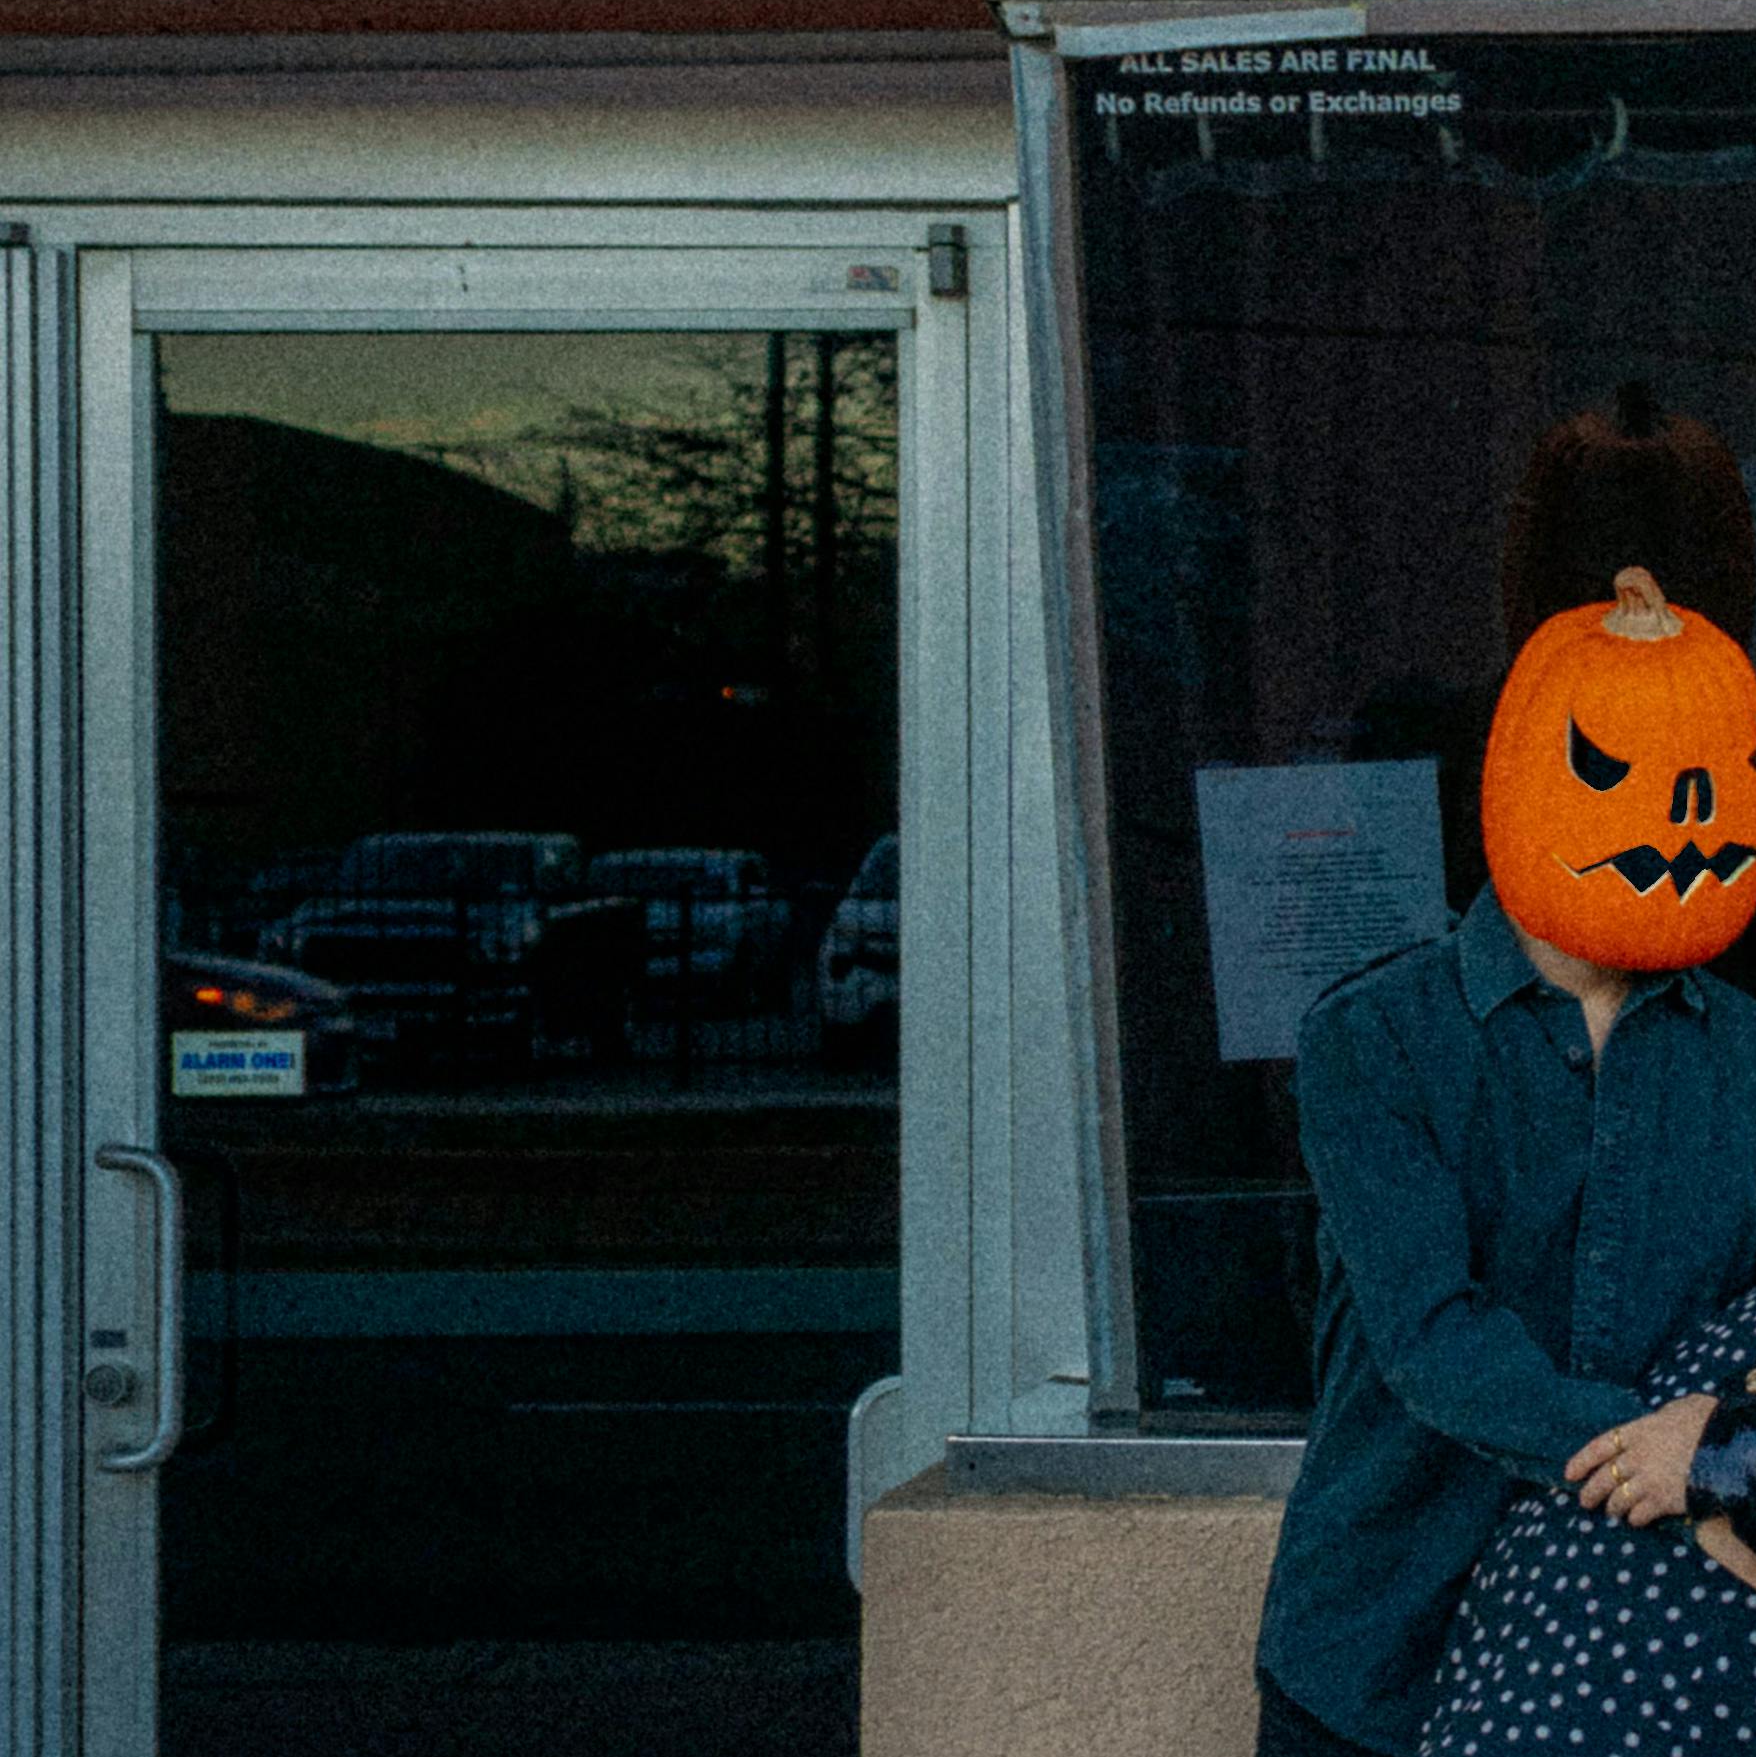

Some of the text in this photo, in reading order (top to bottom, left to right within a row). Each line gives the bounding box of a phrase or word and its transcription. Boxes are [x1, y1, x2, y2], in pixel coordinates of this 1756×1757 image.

[1119, 49, 1436, 73] ALL SALES ARE FINAL
[1095, 90, 1462, 117] No Refunds or Exchanges
[181, 1052, 246, 1069] ALARM
